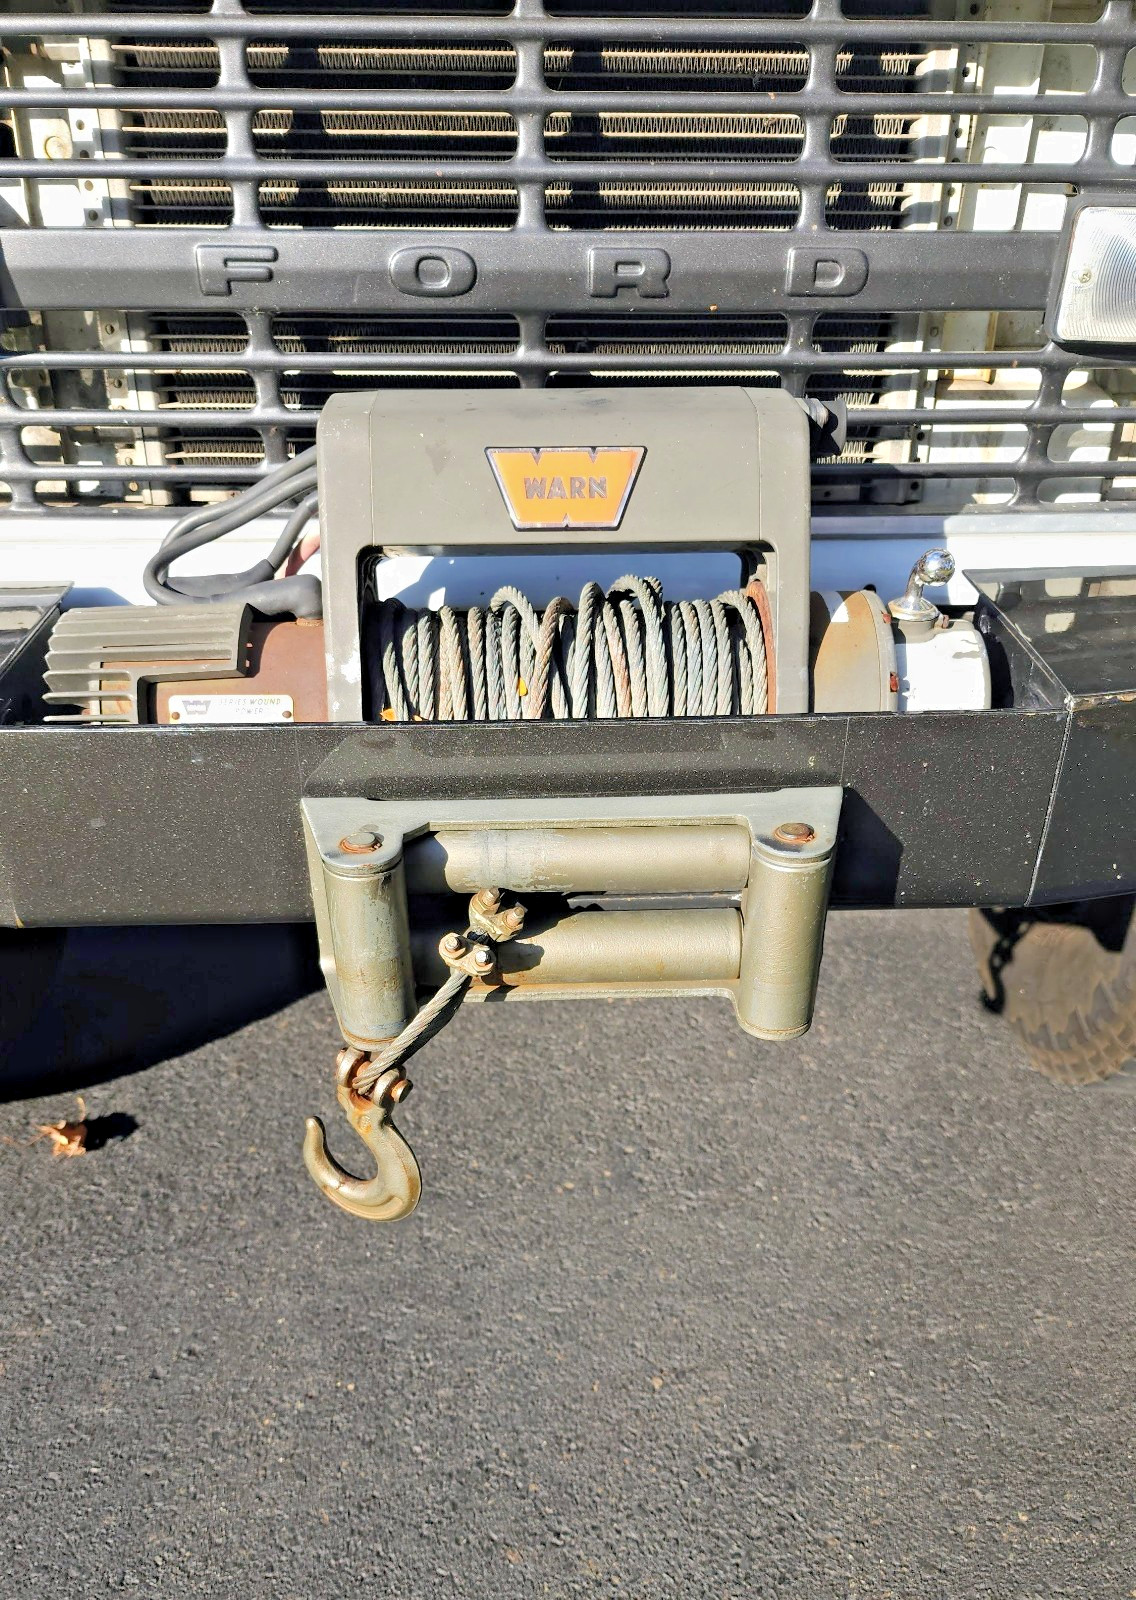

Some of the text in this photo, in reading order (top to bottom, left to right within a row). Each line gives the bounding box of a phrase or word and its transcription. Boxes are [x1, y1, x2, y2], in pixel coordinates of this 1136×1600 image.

[194, 244, 869, 298] FORD
[523, 476, 608, 499] WARN
[249, 697, 281, 705] WOUND
